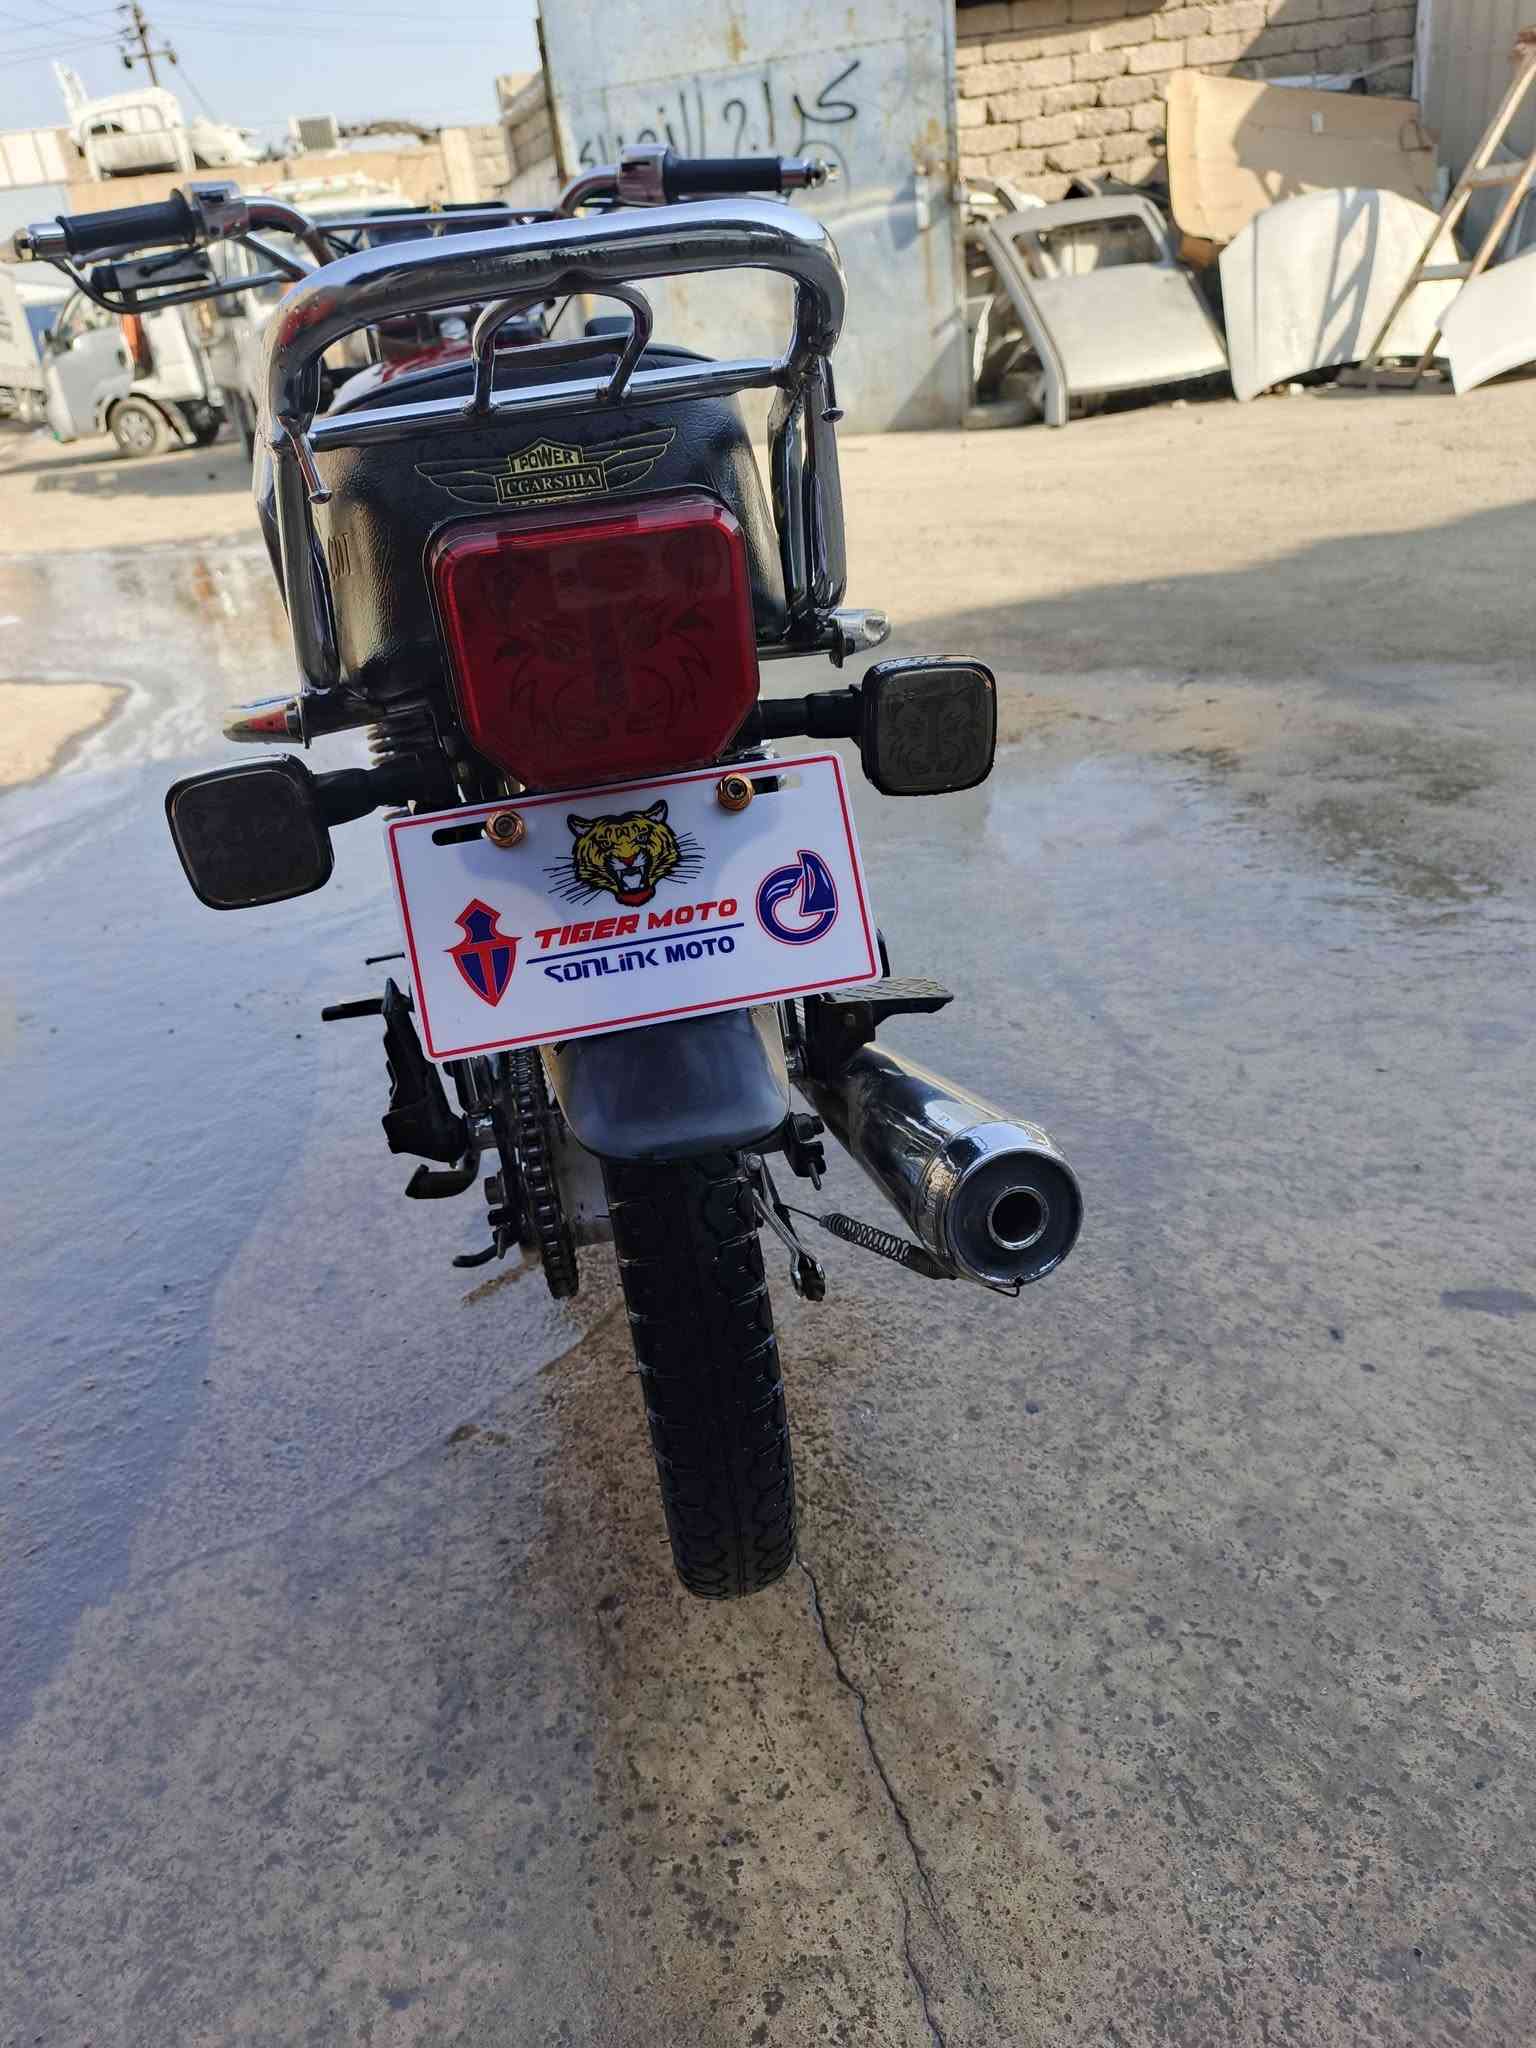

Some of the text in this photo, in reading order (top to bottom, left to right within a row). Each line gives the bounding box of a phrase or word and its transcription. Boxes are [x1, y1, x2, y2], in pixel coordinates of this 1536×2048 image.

[518, 447, 574, 471] POWER
[534, 898, 738, 949] TIGER MOTO
[664, 935, 736, 964] MOTO
